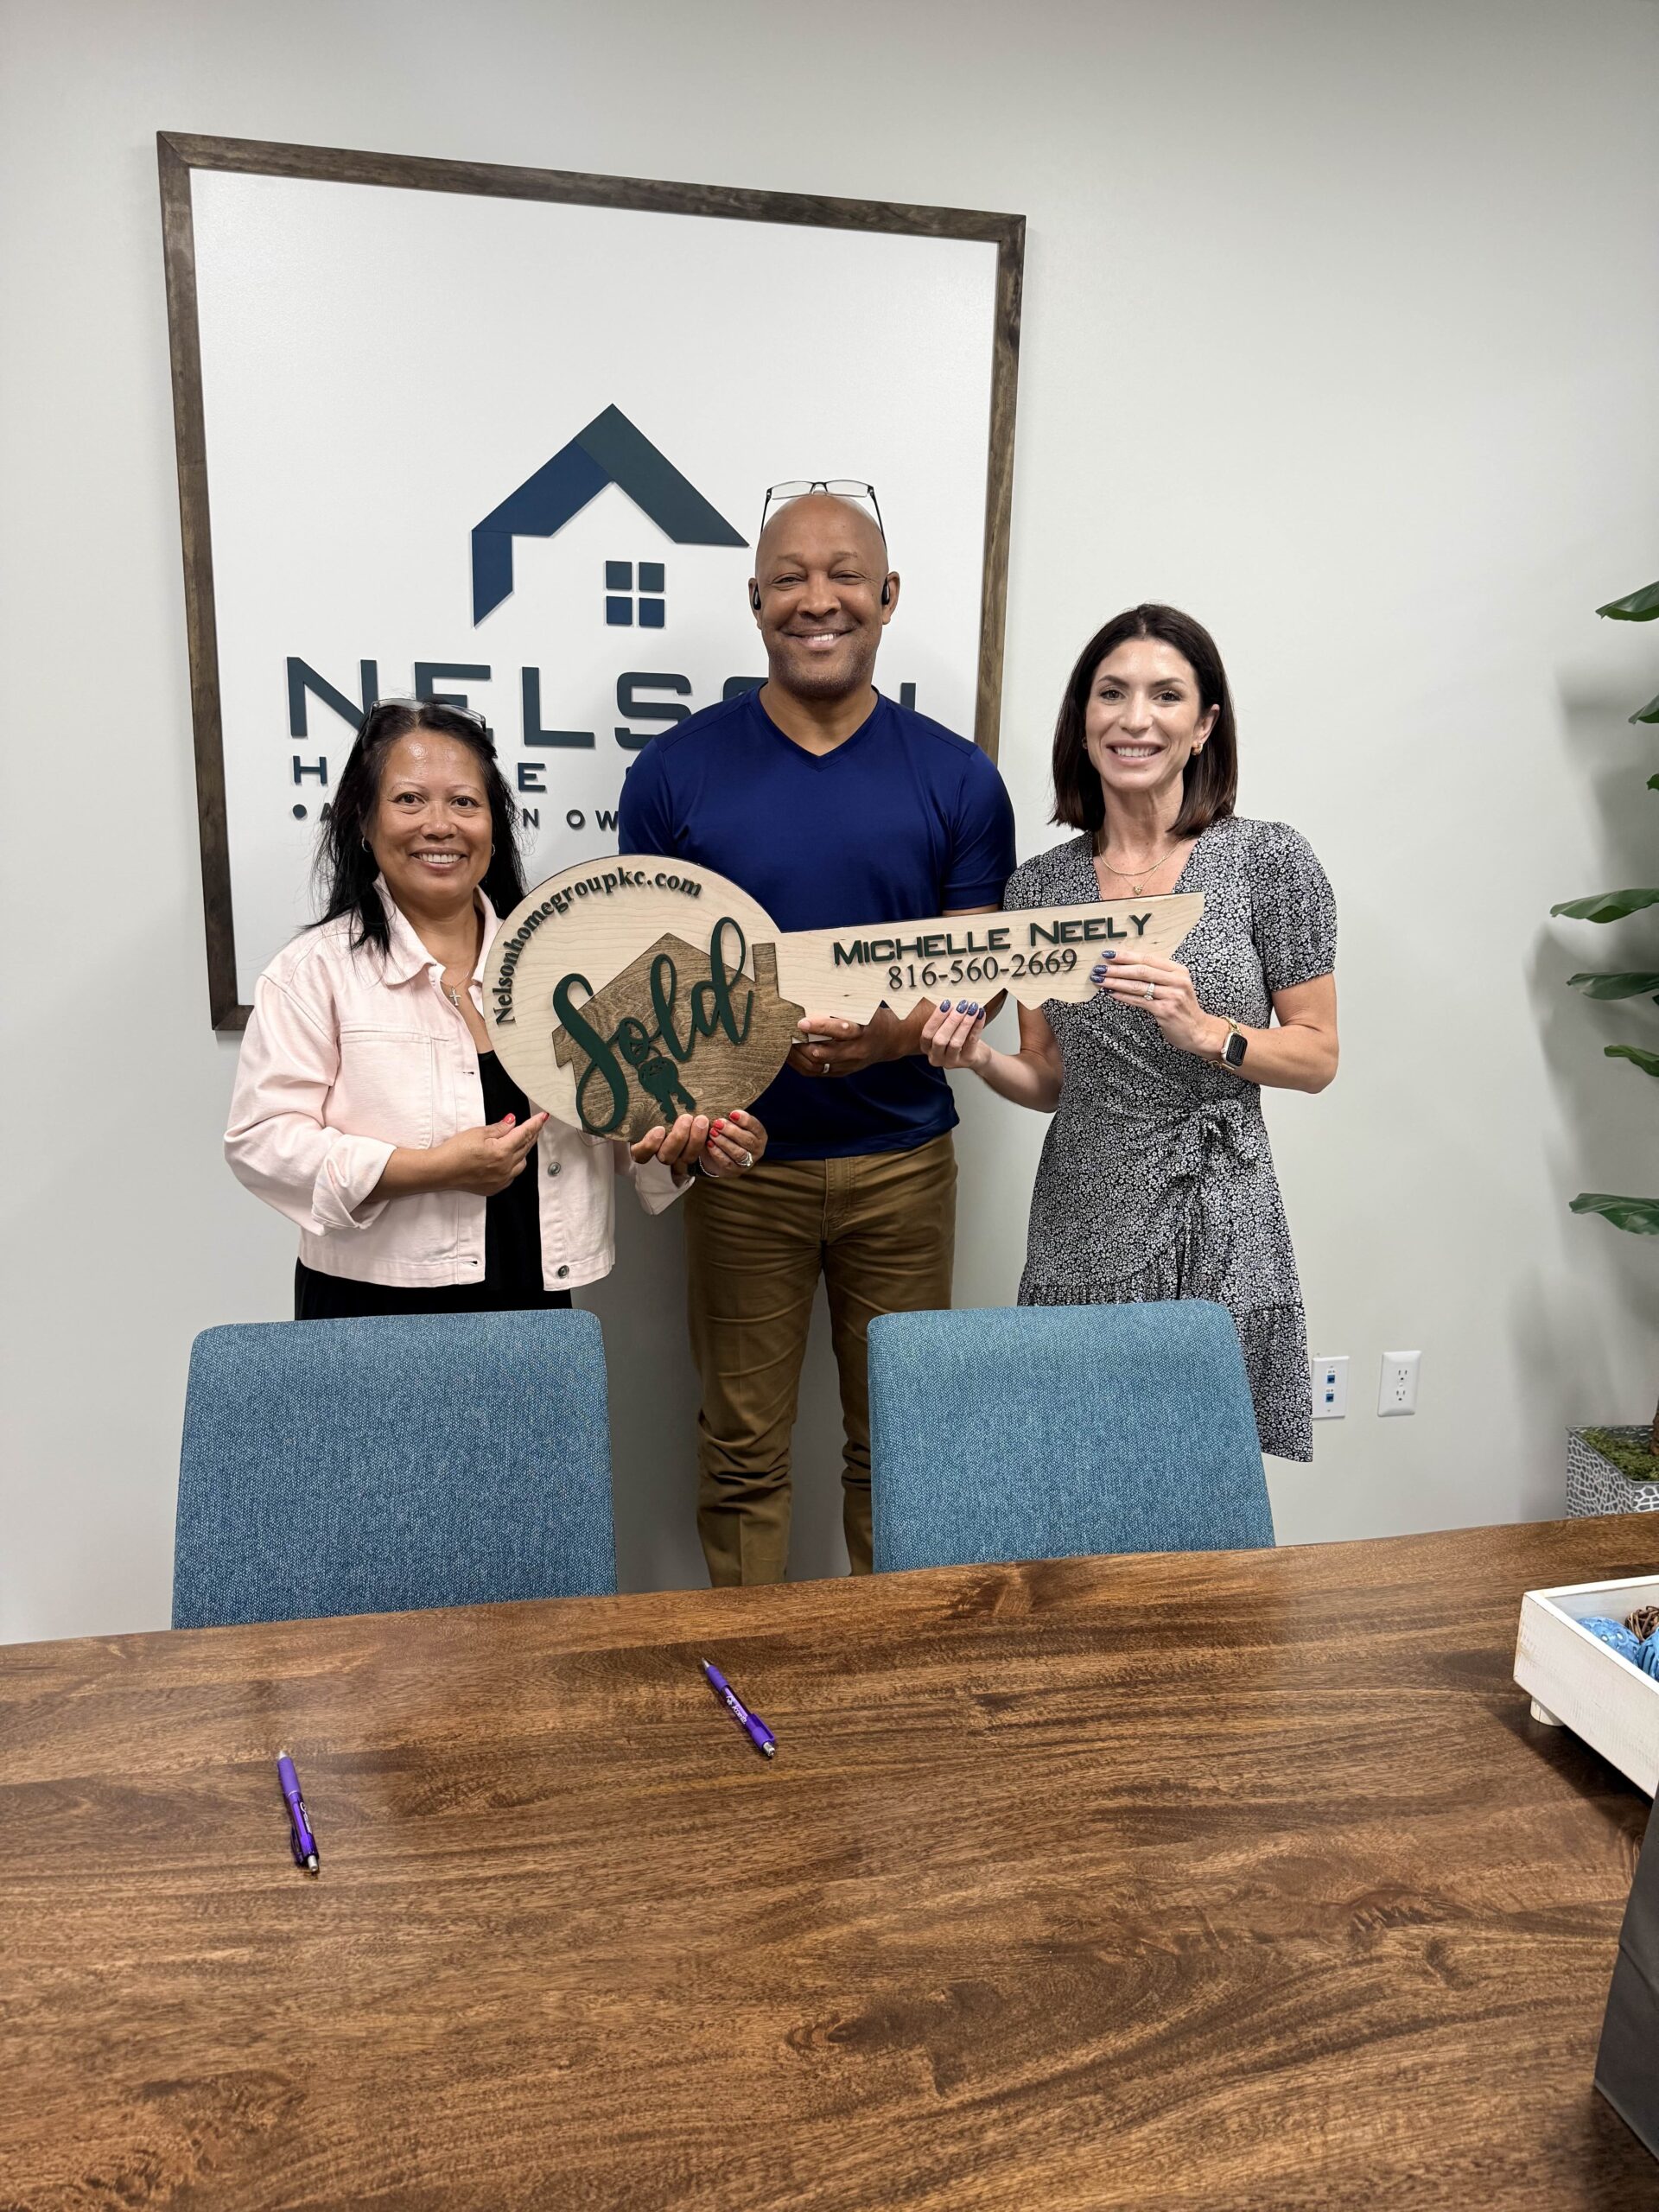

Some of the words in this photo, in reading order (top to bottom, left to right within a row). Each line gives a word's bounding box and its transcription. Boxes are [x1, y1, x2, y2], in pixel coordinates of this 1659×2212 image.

[286, 656, 917, 748] NELS
[493, 867, 702, 1027] Nelsonhomegroupkc.com
[833, 928, 1010, 966] MICHELLE
[1029, 912, 1153, 947] NEELY
[888, 948, 1077, 990] 816-560-2669
[552, 916, 753, 1133] Sold
